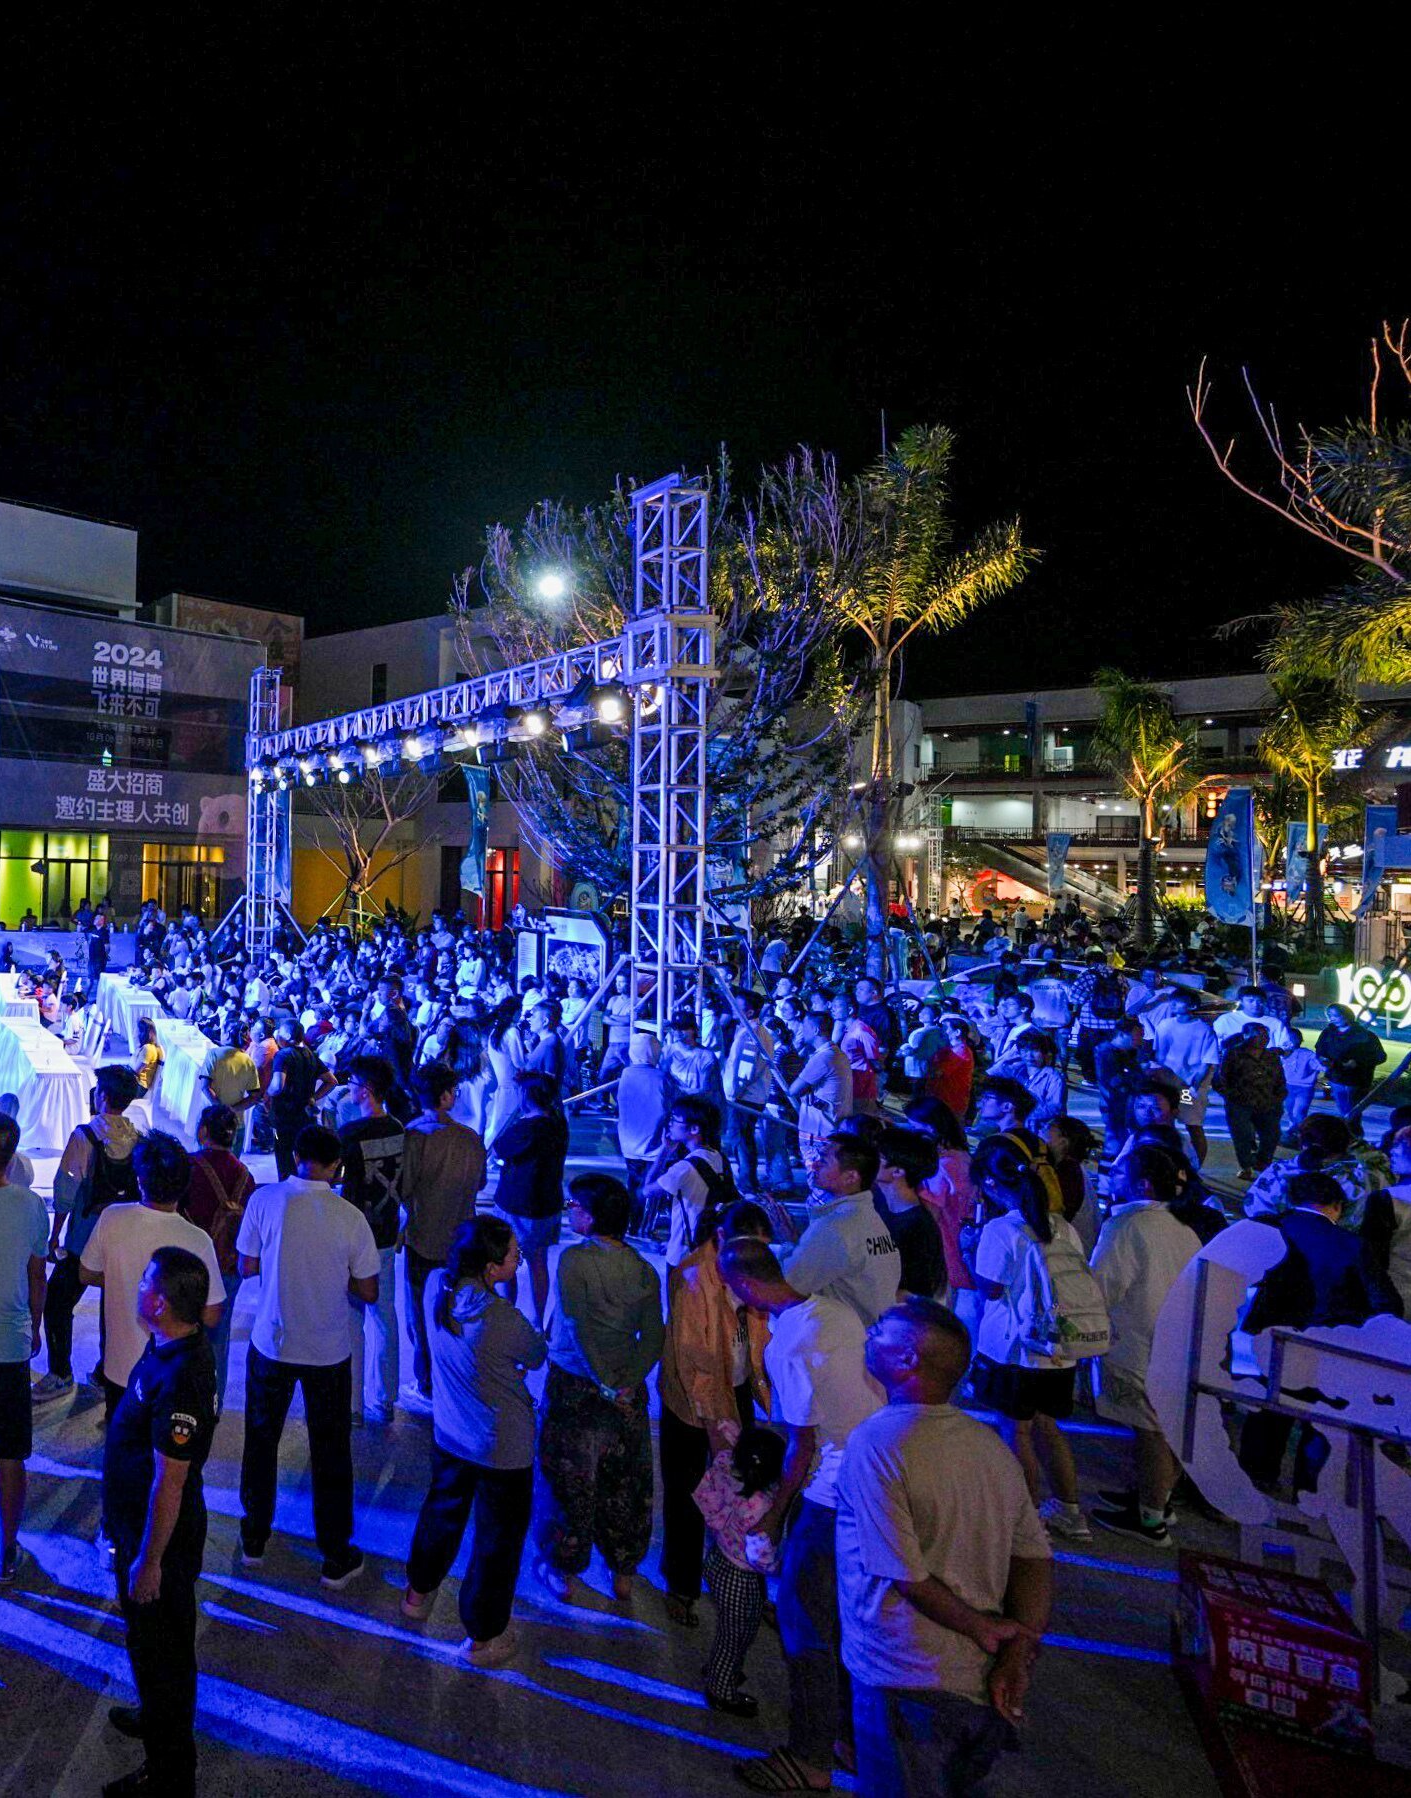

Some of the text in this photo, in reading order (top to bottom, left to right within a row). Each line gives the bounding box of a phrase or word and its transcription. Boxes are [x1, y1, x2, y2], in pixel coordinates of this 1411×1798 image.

[93, 641, 164, 670] 2024
[92, 665, 163, 697] 世界海湾
[91, 689, 161, 720] 飞来不可
[86, 769, 163, 796] 盛大招商
[55, 795, 189, 826] 邀约主理人共创
